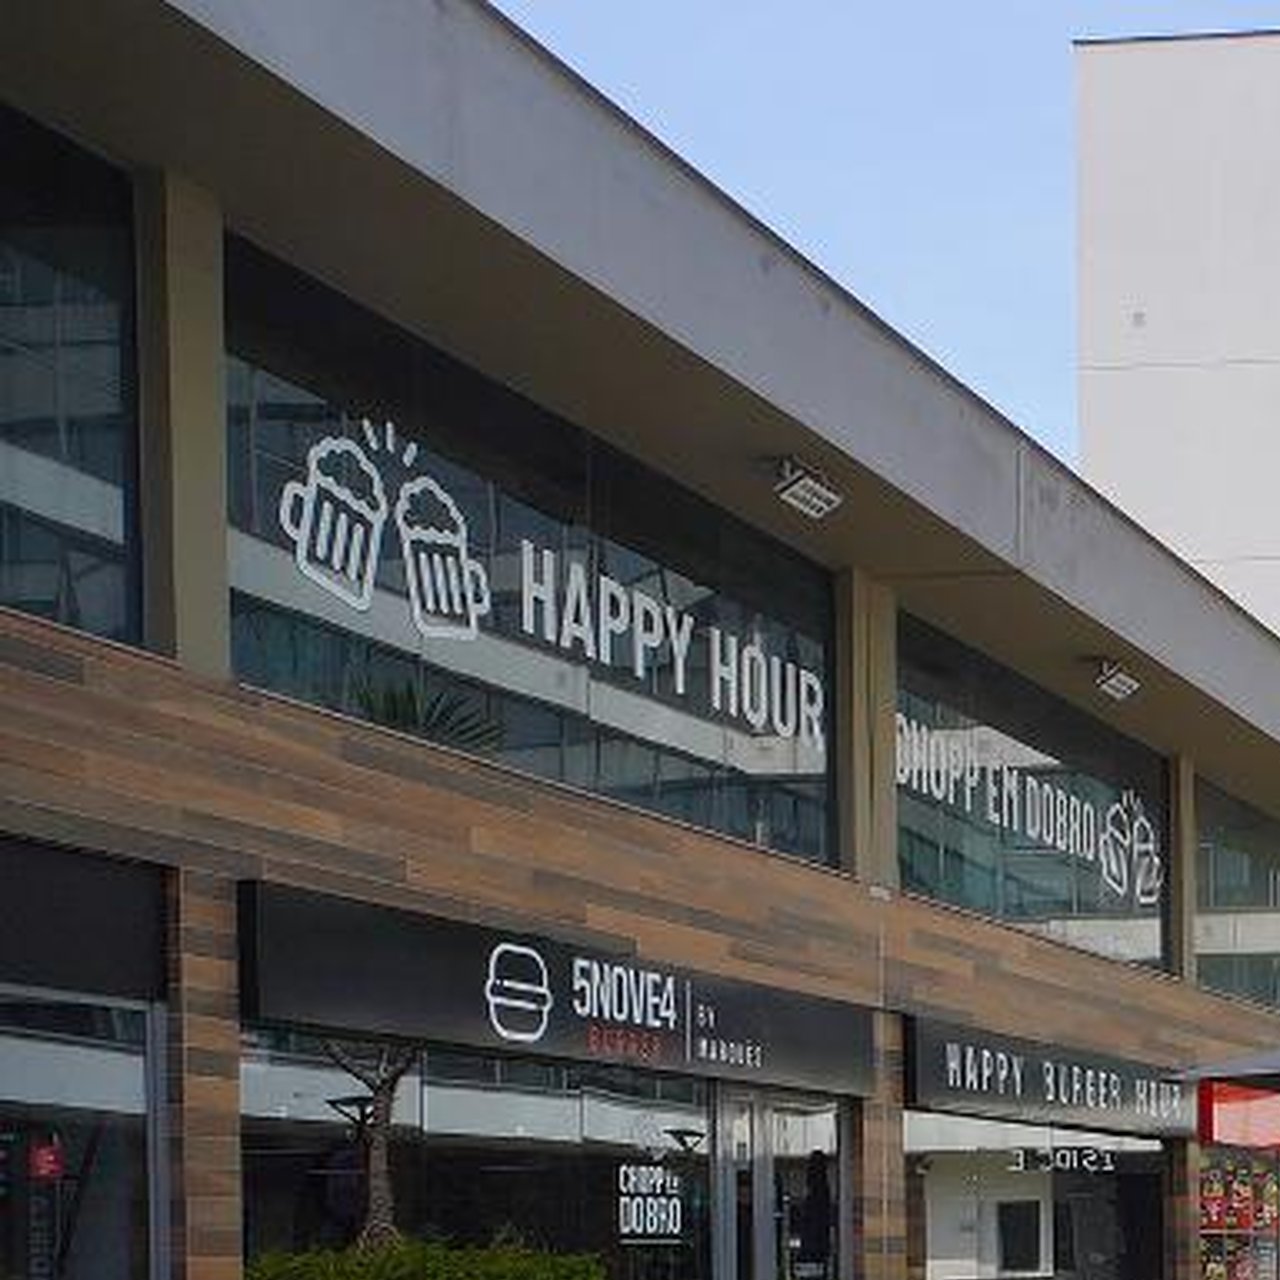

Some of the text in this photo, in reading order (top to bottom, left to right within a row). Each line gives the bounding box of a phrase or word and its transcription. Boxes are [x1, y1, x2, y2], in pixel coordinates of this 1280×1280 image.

[521, 539, 824, 758] HAPPY HOUR
[1025, 774, 1094, 861] DOBRO
[572, 957, 677, 1030] 5NOVE4
[946, 1043, 1182, 1119] HAPPY BURGER HOUR
[619, 1196, 681, 1234] DOBRO
